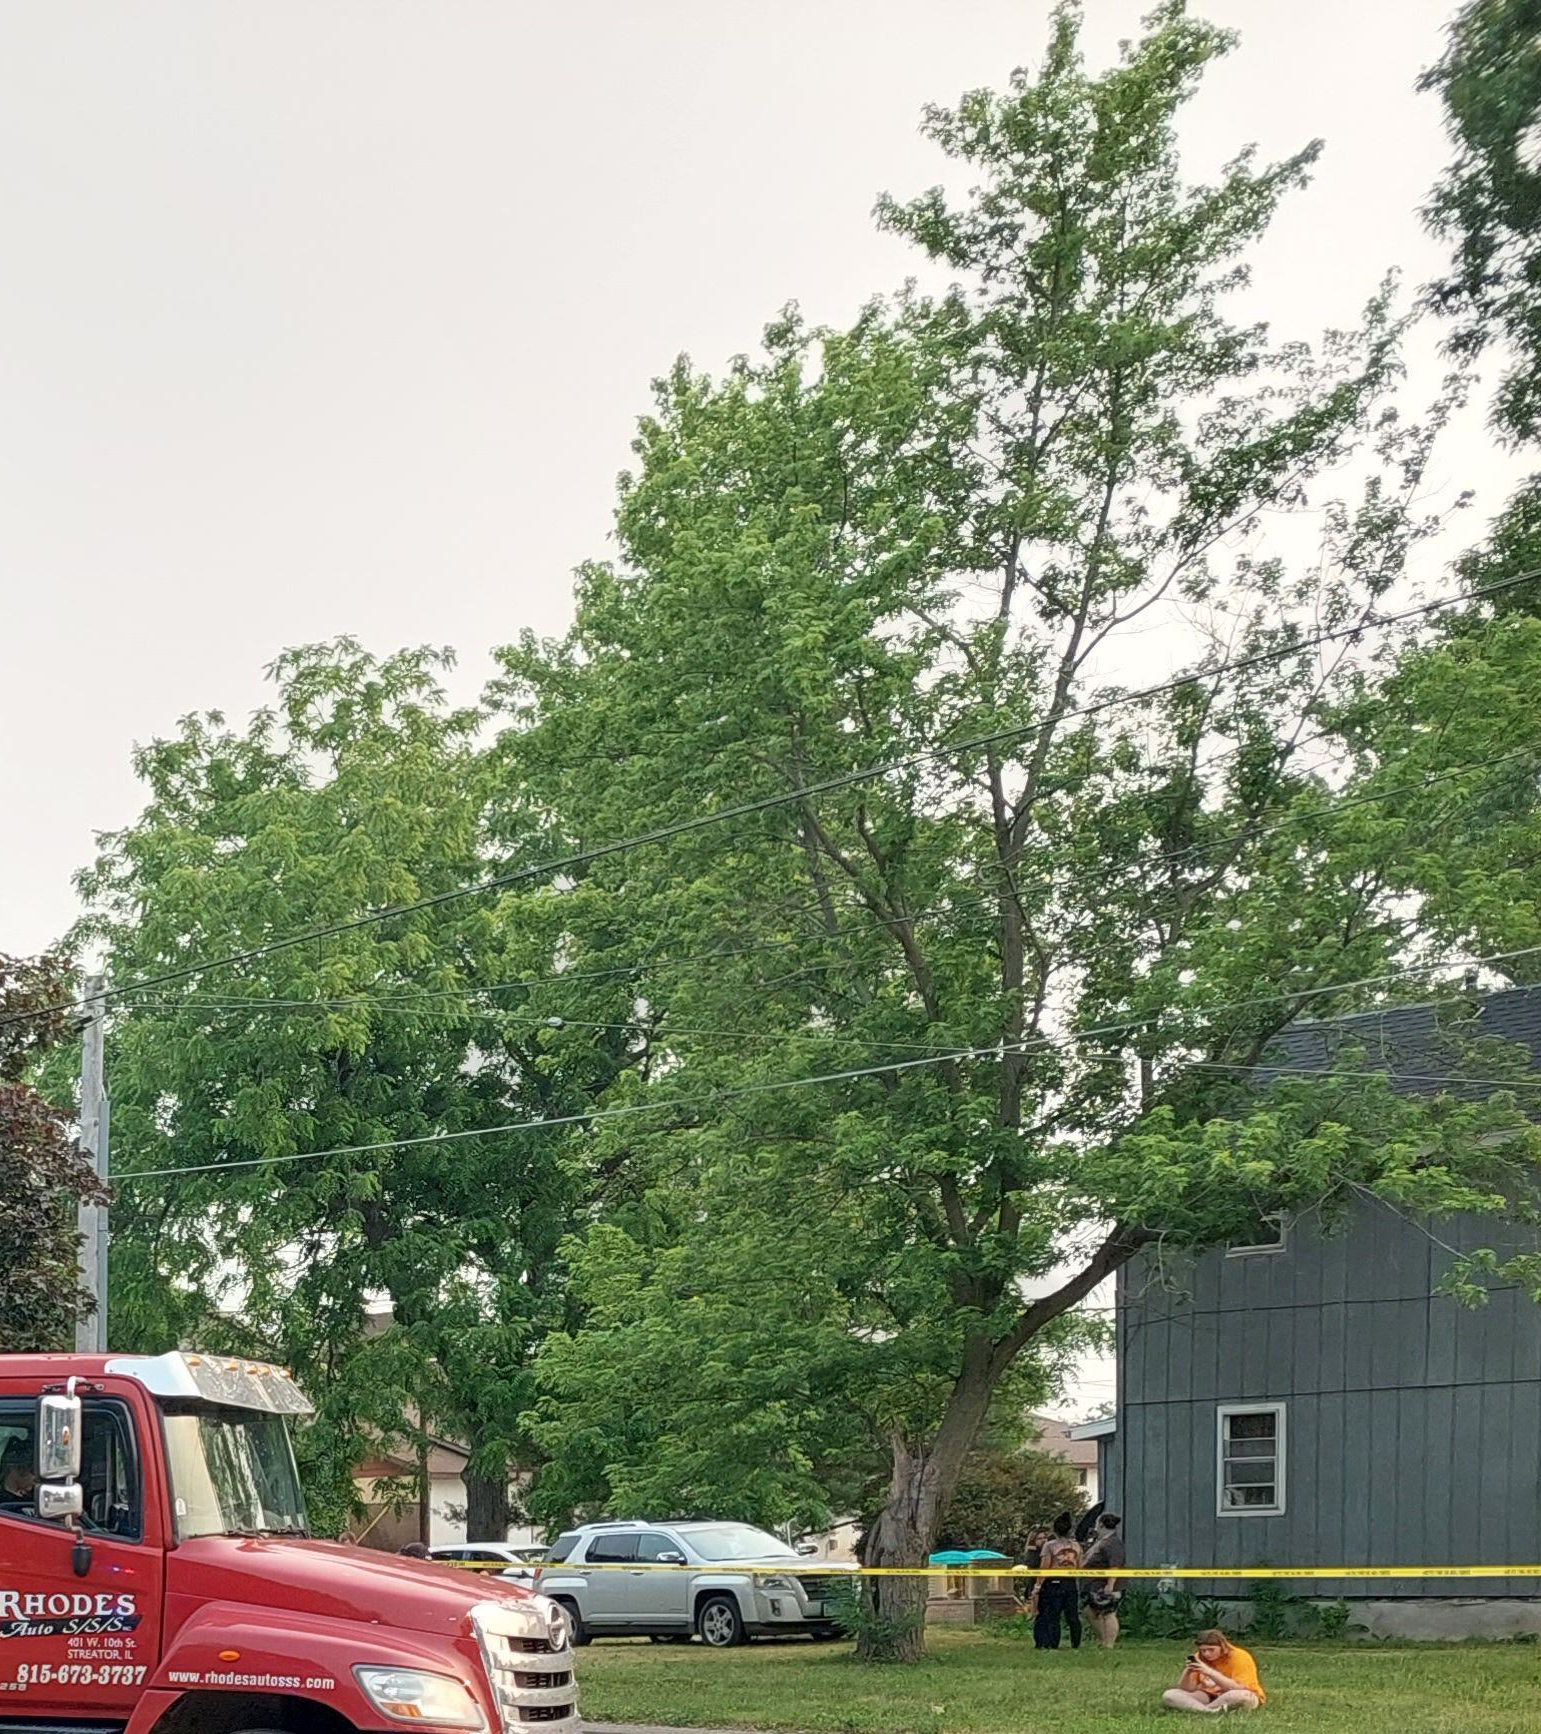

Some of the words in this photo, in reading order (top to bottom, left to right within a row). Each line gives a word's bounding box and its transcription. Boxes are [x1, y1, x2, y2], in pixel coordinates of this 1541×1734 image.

[67, 1637, 84, 1648] 401
[86, 1637, 101, 1648] W.
[103, 1637, 124, 1648] 10th
[124, 1650, 134, 1660] IL
[16, 1663, 147, 1686] 815-673-3737
[168, 1670, 335, 1690] www.rhodesautosss.com
